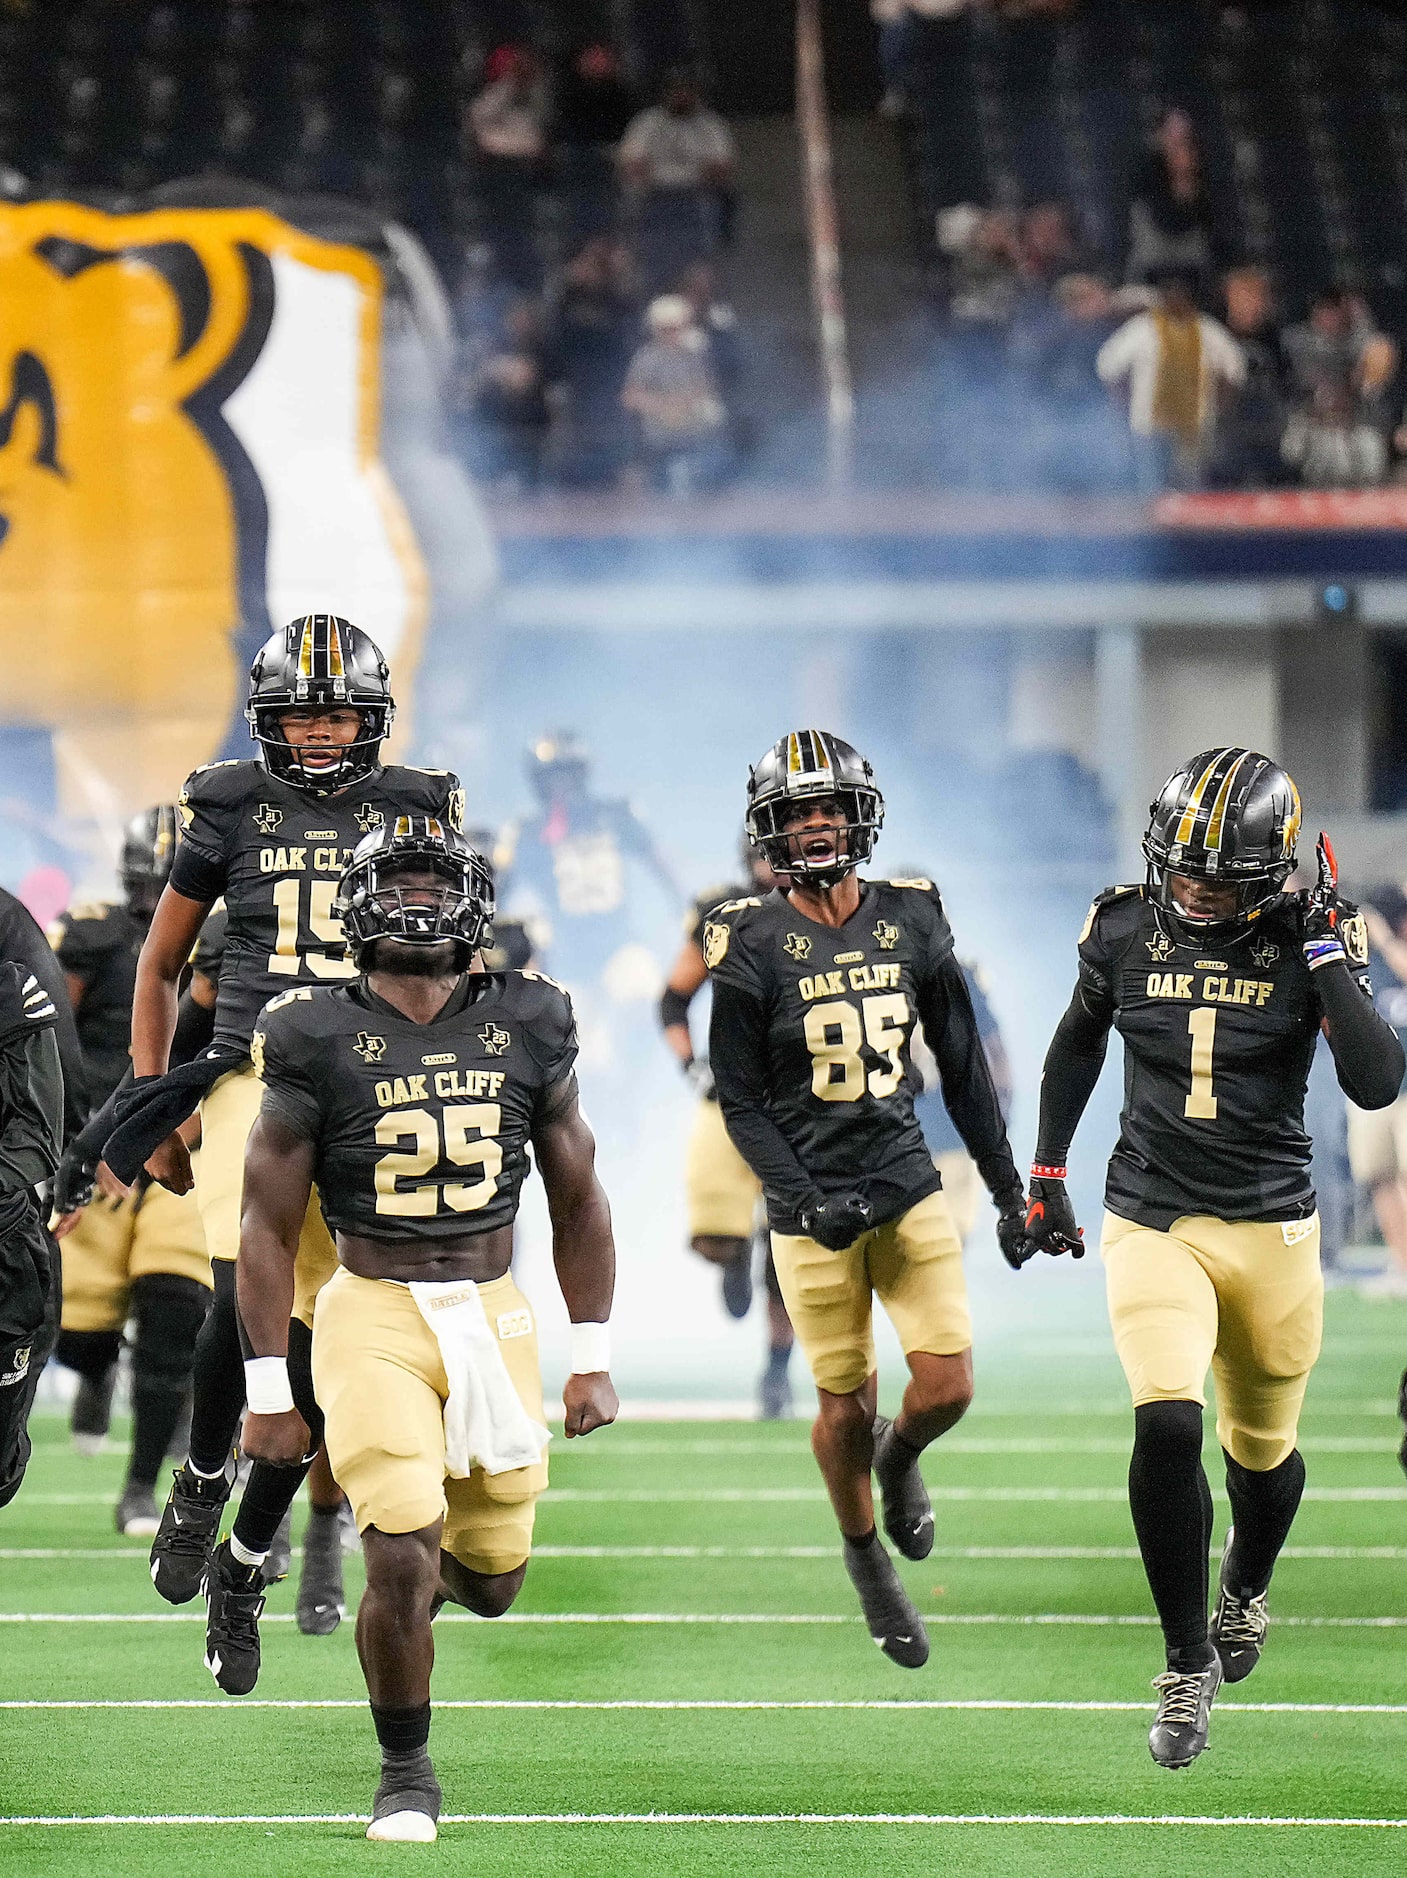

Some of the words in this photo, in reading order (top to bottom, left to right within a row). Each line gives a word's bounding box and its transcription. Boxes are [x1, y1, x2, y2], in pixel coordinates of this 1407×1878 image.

[265, 811, 276, 823] 21
[367, 811, 380, 823] 22
[259, 847, 306, 873] OAK
[267, 878, 361, 979] 15
[1158, 939, 1169, 951] 21
[1262, 946, 1275, 958] 22
[798, 971, 845, 1001] OAK
[848, 964, 902, 991] CLIFF
[1146, 973, 1194, 999] OAK
[1202, 976, 1274, 1006] CLIFF
[366, 1039, 378, 1050] 21
[493, 1032, 507, 1043] 22
[803, 993, 910, 1102] 85
[1184, 1007, 1218, 1119] 1
[374, 1074, 429, 1107] OAK
[434, 1070, 506, 1098] CLIFF
[374, 1103, 503, 1216] 25
